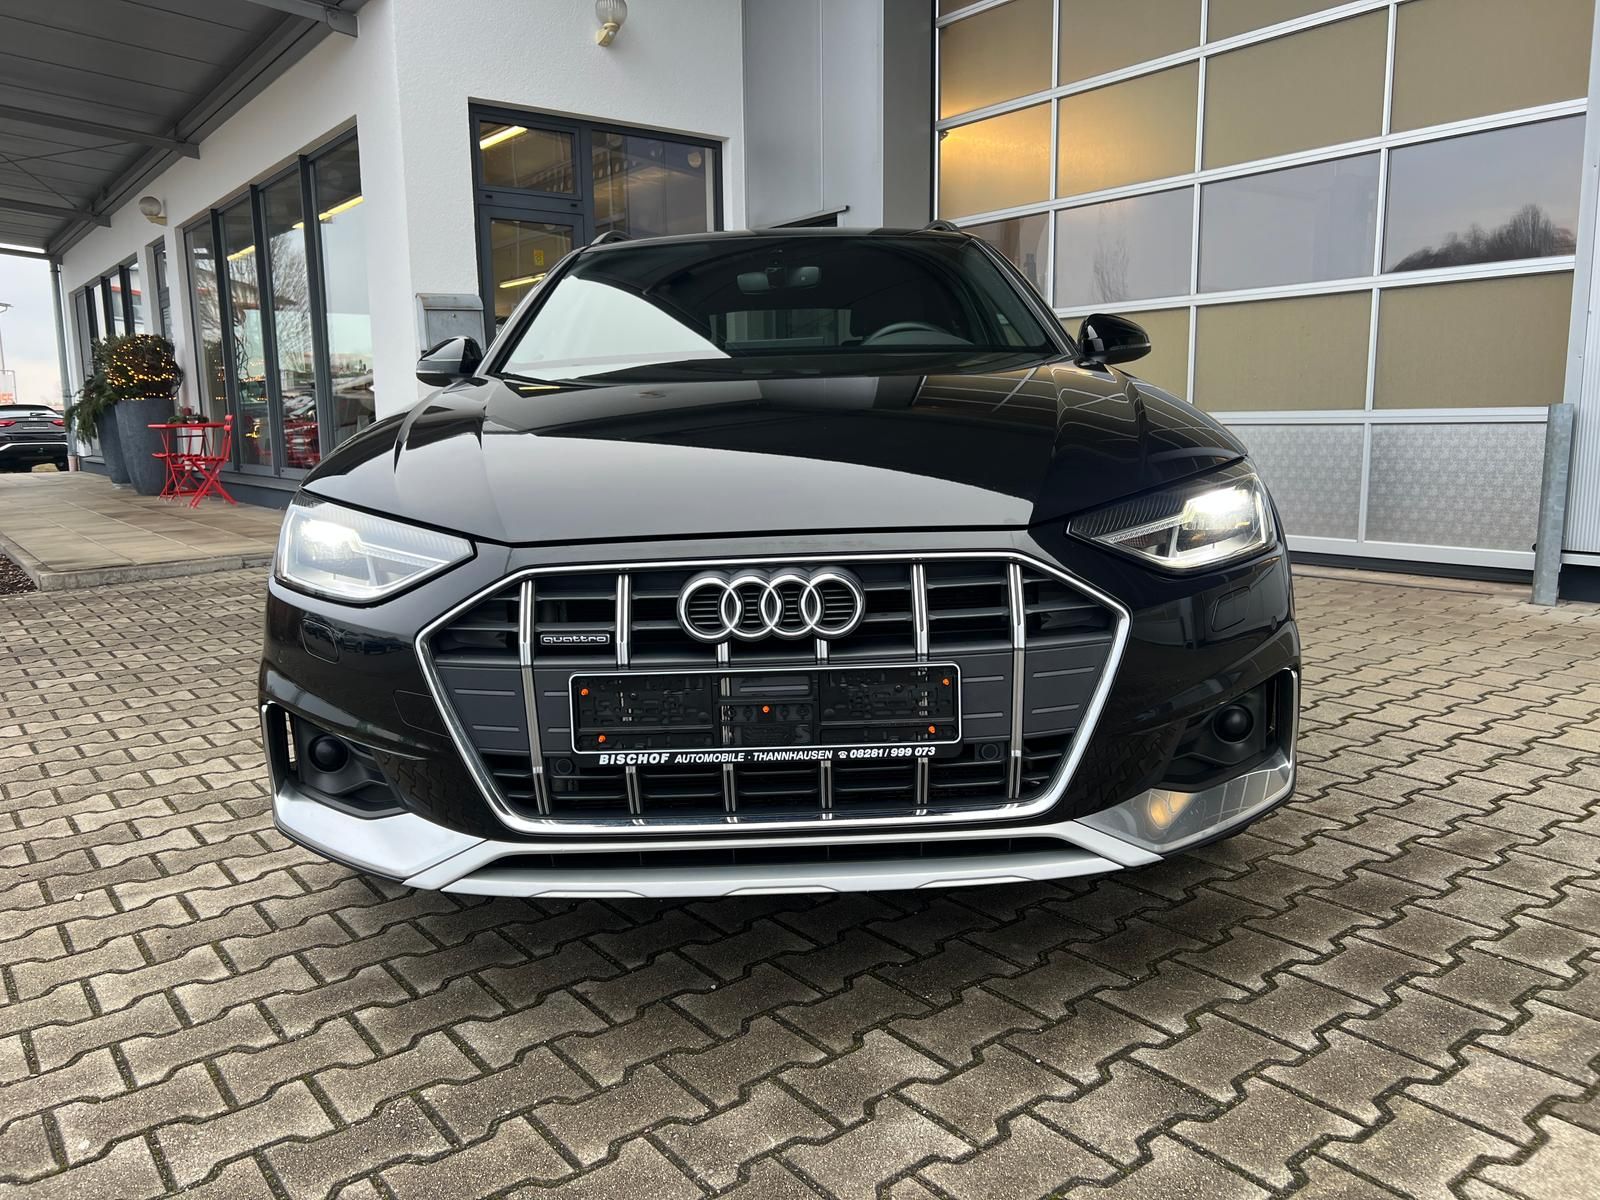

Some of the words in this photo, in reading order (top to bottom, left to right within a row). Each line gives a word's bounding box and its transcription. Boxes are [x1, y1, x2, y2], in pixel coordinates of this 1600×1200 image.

[543, 635, 607, 644] quattro
[599, 753, 670, 765] BISCHOF
[674, 752, 745, 763] AUTOMOBILE
[752, 750, 833, 761] THANNHAUSEN
[890, 747, 912, 757] 999
[914, 746, 936, 756] 073
